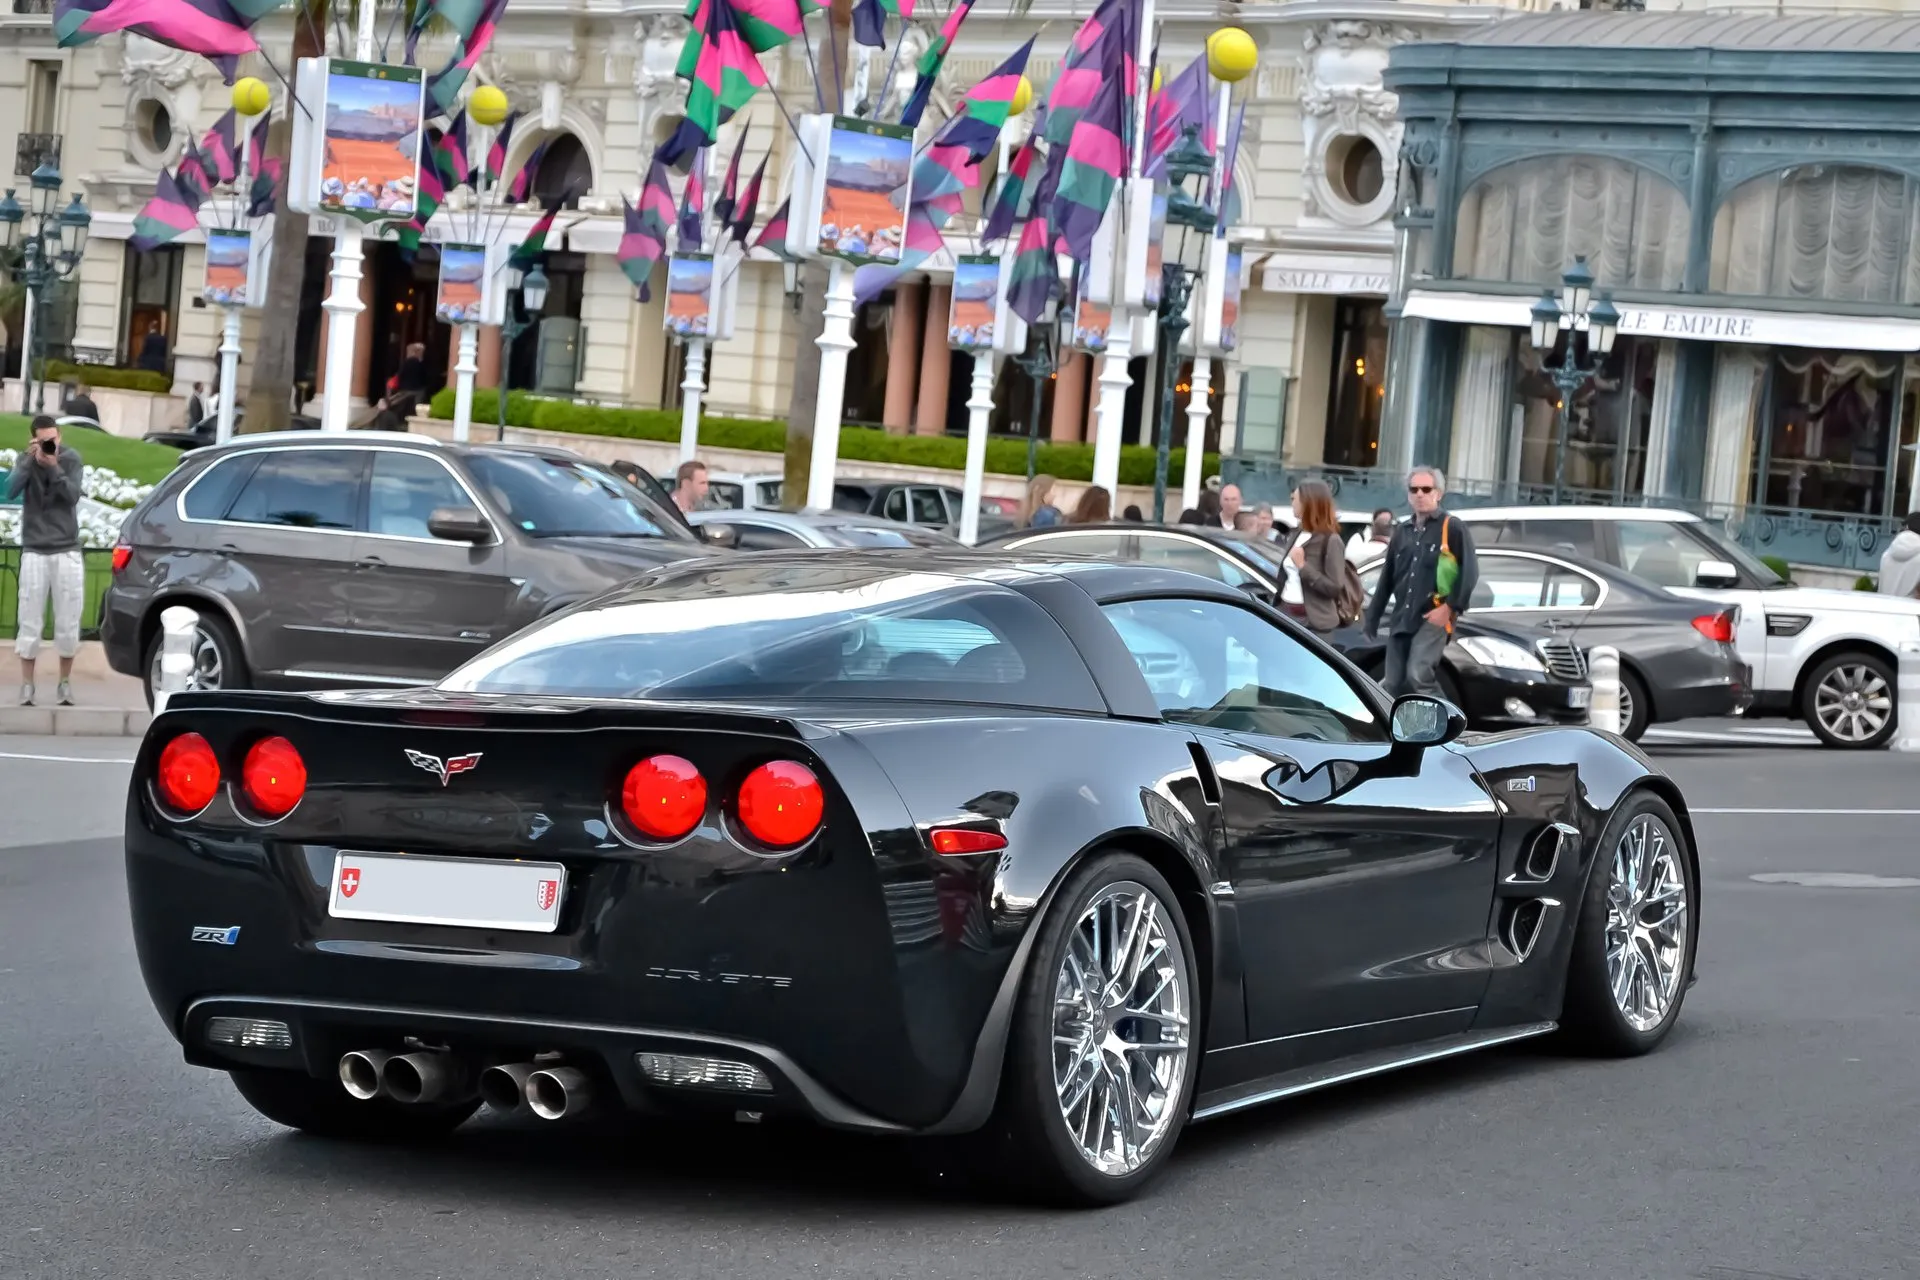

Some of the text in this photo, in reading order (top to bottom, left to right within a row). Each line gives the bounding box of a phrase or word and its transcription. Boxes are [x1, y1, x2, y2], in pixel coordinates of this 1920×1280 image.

[1277, 271, 1333, 289] SALLE
[1662, 313, 1754, 337] EMPIRE
[191, 926, 241, 945] ZR1
